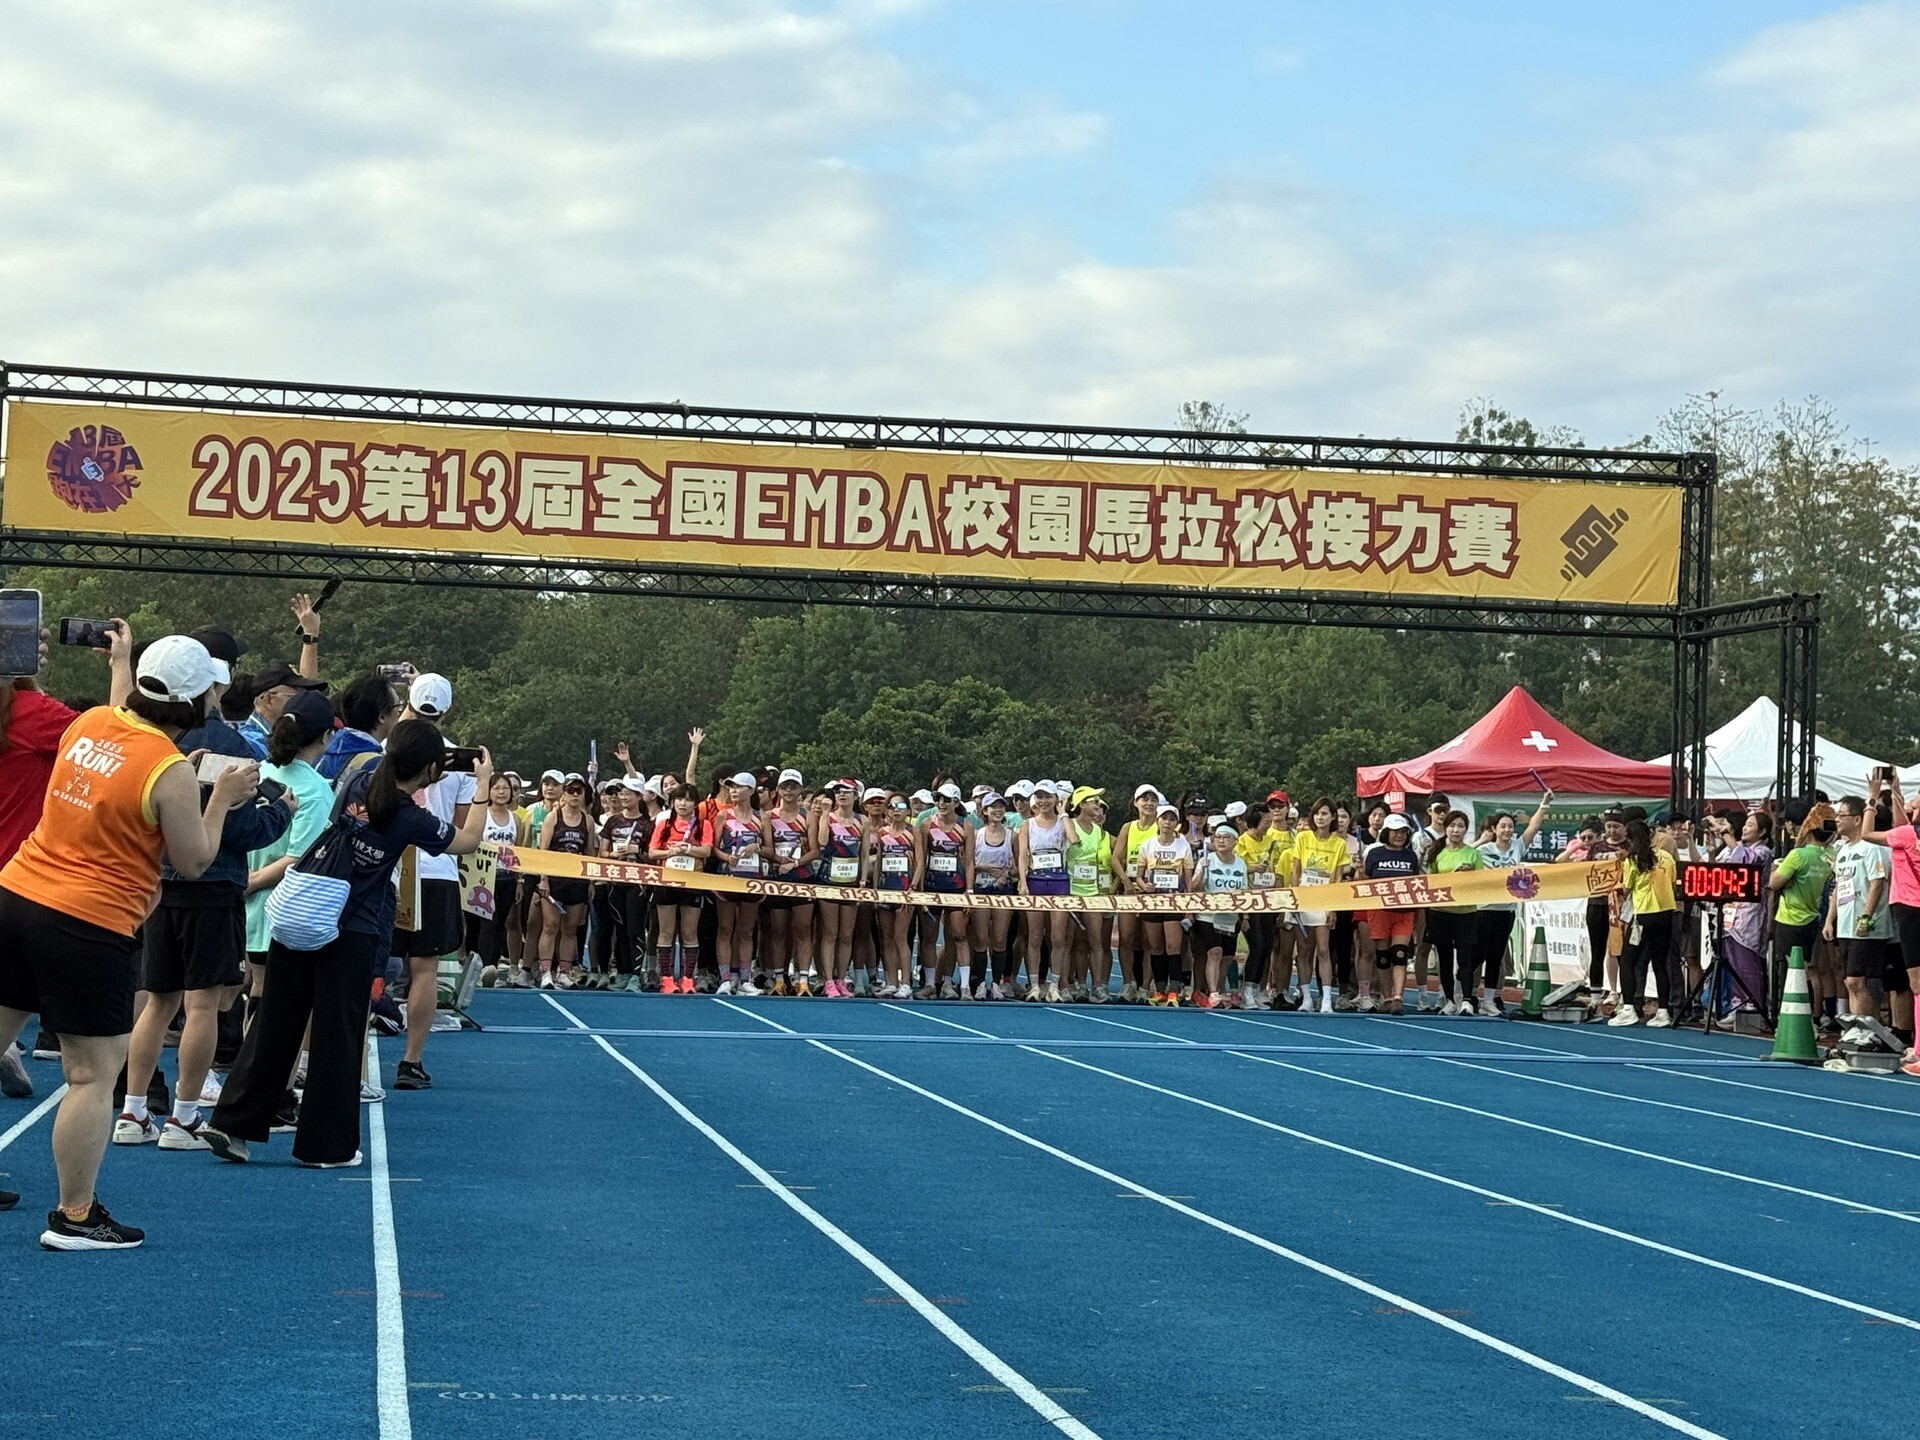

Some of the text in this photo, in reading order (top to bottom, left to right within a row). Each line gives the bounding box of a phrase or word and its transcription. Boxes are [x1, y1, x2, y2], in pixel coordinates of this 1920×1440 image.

[190, 437, 1518, 577] 2025第13屆全國EMBA校園馬拉松接力賽
[65, 736, 123, 778] RUN!
[476, 859, 491, 873] UP
[1379, 861, 1411, 869] NKUST
[1214, 879, 1241, 889] CYCU
[1356, 878, 1425, 896] 跑在高大
[1685, 866, 1759, 897] 00:04:21
